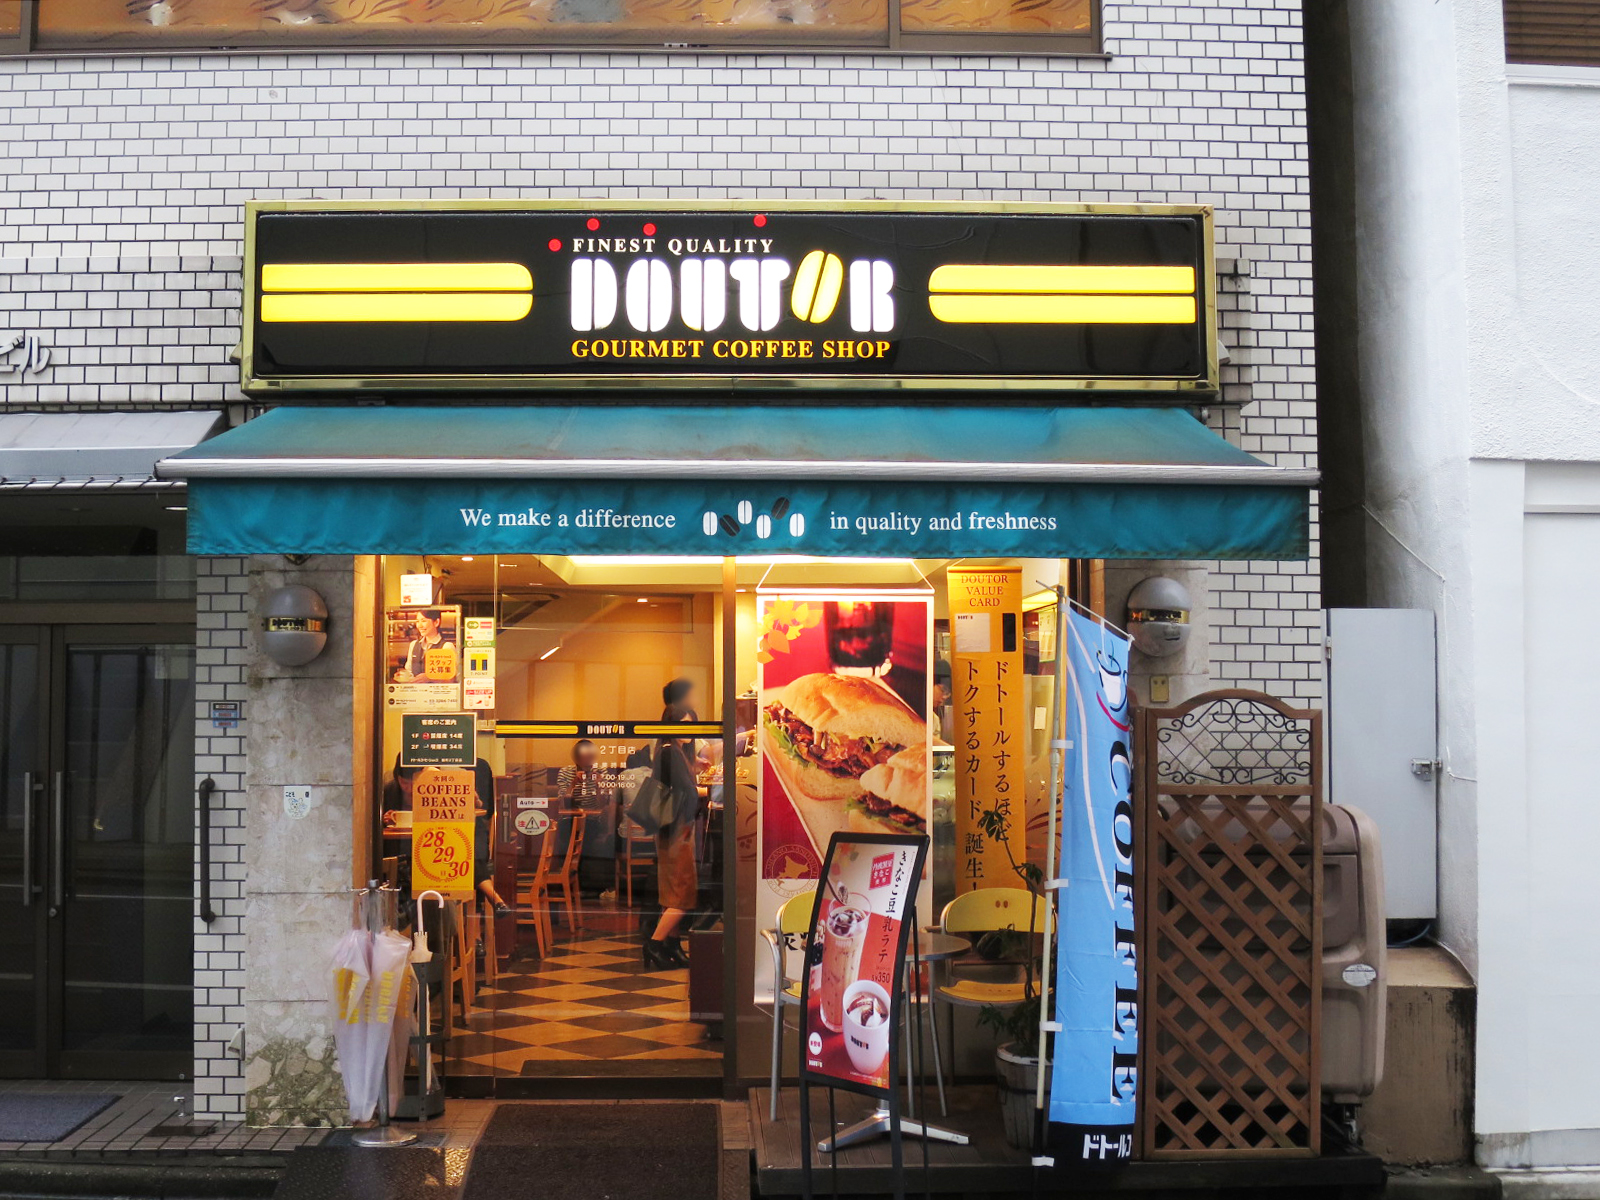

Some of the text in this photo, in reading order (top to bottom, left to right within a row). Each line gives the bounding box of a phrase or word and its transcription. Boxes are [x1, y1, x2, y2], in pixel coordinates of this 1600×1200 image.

[572, 238, 775, 256] FINEST QUALITY
[570, 250, 895, 332] DOUTOR
[571, 339, 891, 358] GOURMET COFFEE SHOP
[460, 508, 676, 529] We make a difference
[830, 511, 1057, 535] in quality and freshness
[961, 574, 1009, 584] DOUTOR
[966, 586, 1004, 596] VALUE
[969, 597, 1001, 607] CARD
[586, 724, 625, 735] DOUTOR
[417, 784, 471, 795] COFFEE
[421, 796, 467, 807] BEANS
[429, 808, 457, 820] DAY
[422, 830, 445, 847] 28
[432, 846, 455, 863] 29
[448, 861, 470, 878] 30
